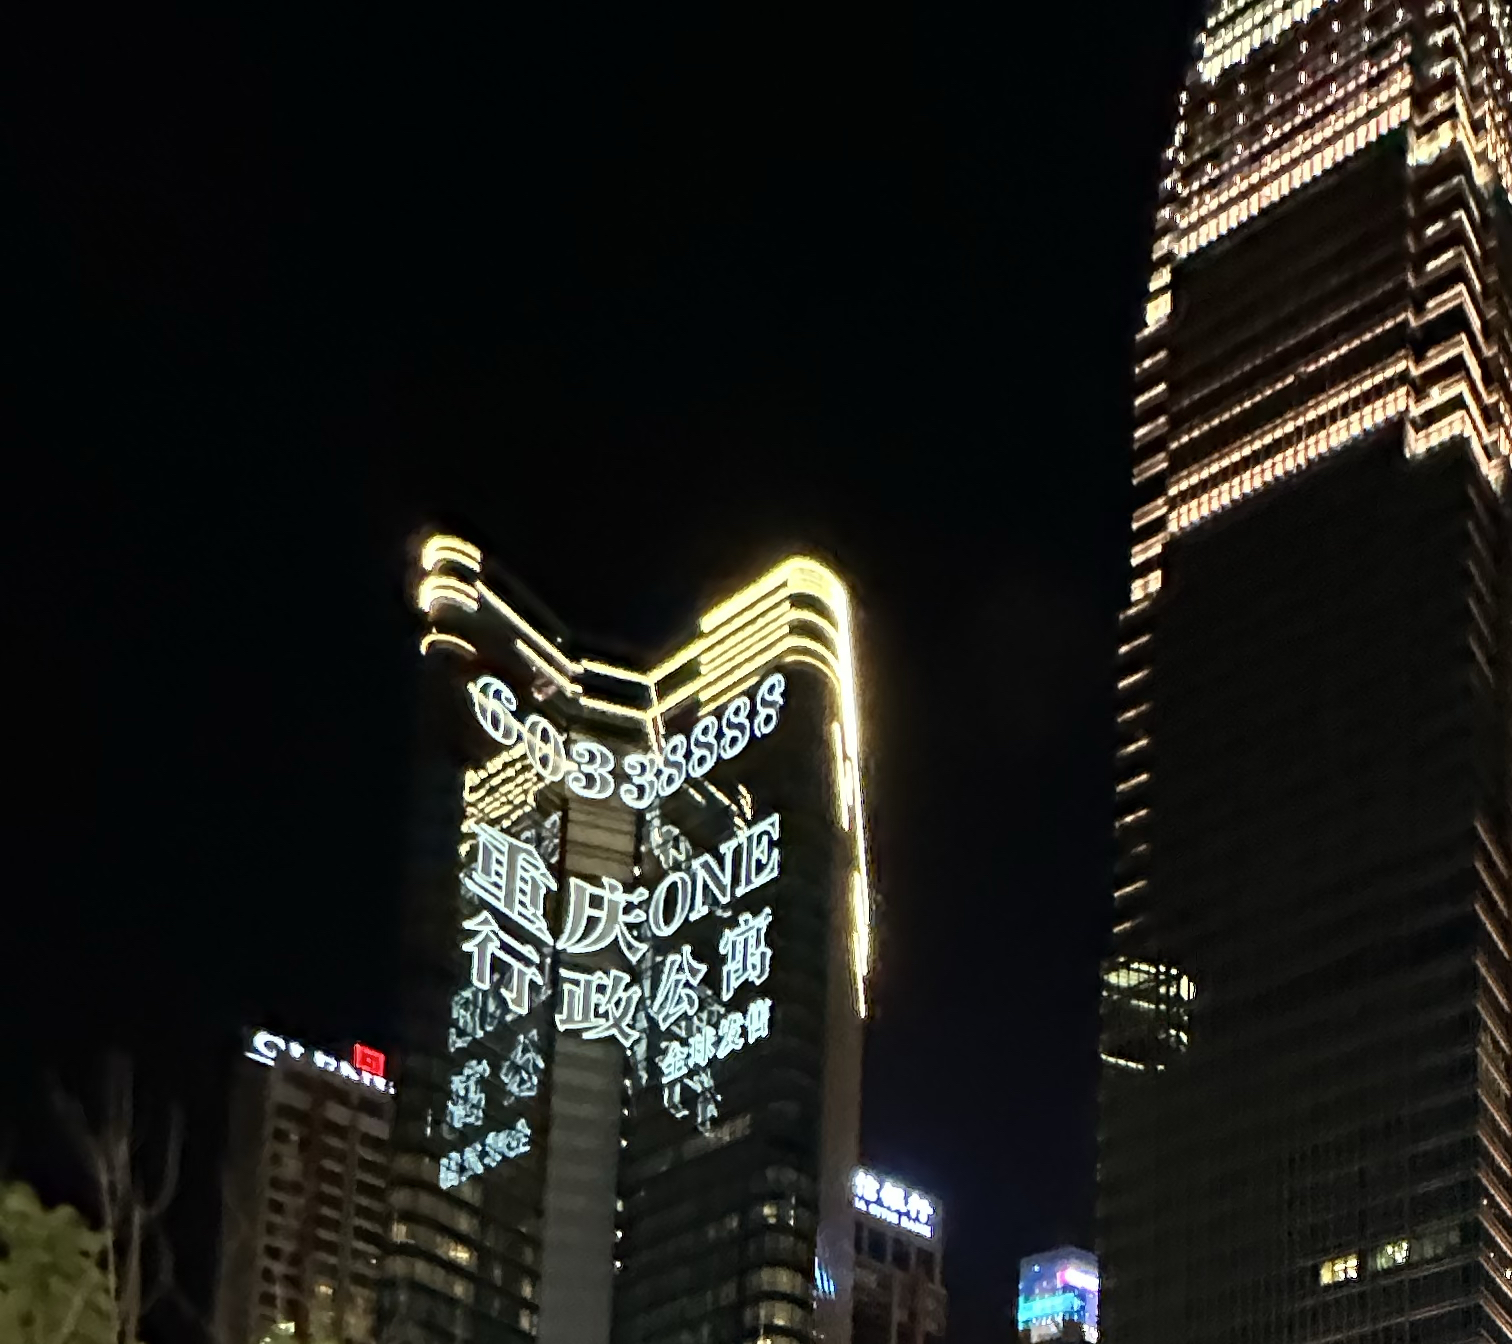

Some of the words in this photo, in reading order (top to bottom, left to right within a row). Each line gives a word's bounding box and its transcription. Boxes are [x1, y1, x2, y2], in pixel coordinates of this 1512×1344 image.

[462, 812, 783, 965] 重庆ONE
[460, 905, 774, 1050] 行政公寓
